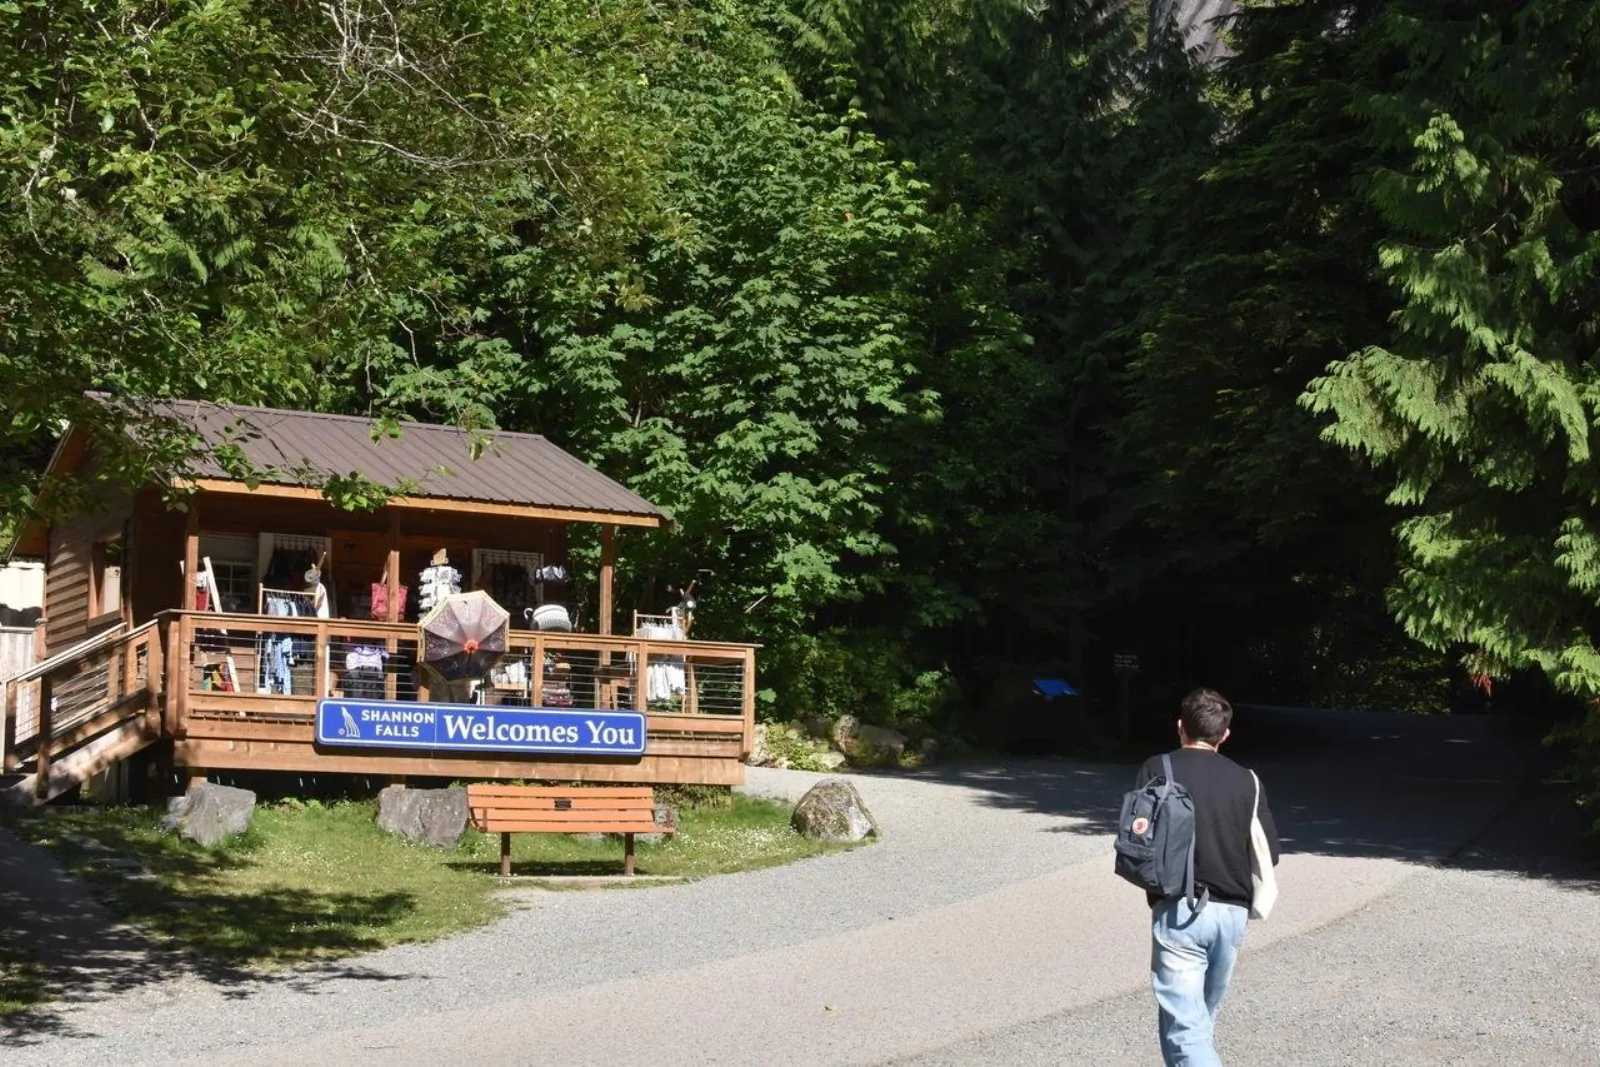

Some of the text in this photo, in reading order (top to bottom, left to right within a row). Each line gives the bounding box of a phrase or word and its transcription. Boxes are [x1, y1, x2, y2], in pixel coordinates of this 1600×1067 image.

[361, 709, 434, 724] SHANNON
[375, 724, 420, 738] FALLS
[443, 714, 636, 746] Welcomes You
